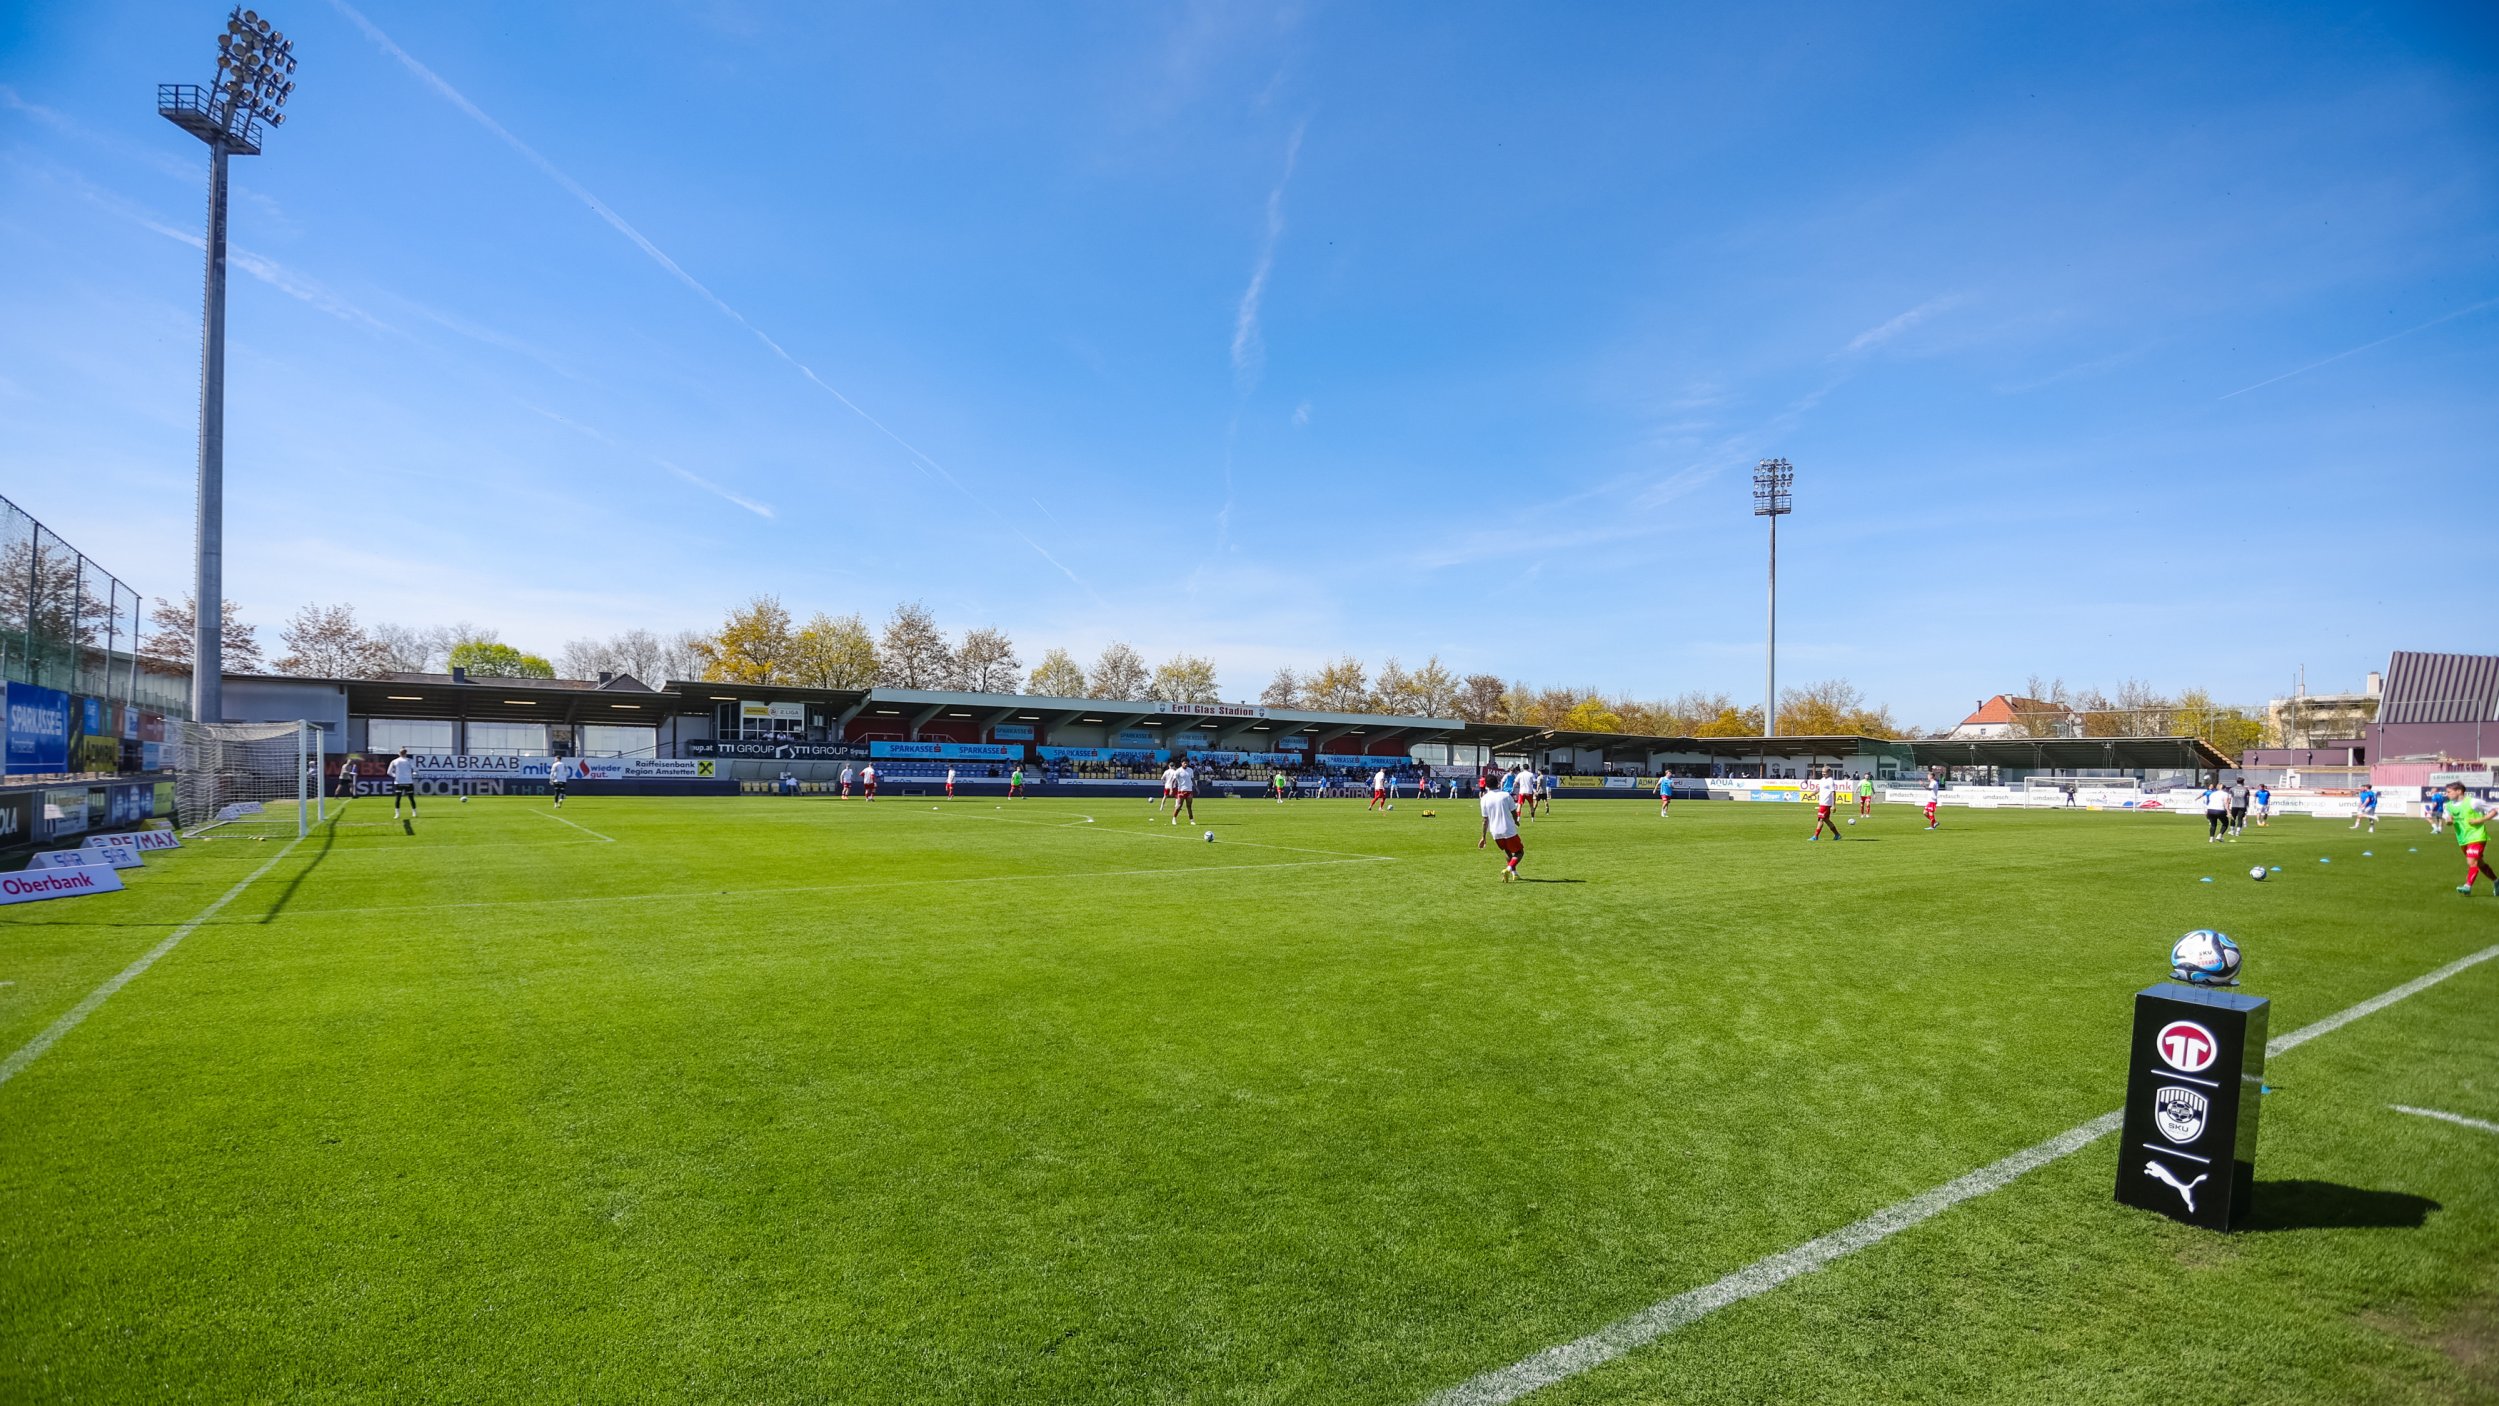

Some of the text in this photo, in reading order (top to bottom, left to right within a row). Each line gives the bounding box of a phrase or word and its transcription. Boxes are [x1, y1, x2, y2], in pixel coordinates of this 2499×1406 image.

[1172, 704, 1254, 716] Ertl Glas Stadion
[718, 744, 735, 753] TTI
[736, 745, 775, 753] GROUP
[794, 746, 810, 754] TTI
[812, 746, 848, 755] GROUP
[889, 744, 1000, 754] SPARKASSE SPARKASSE
[1053, 749, 1091, 757] SPARKASSE
[591, 764, 622, 772] wieder
[635, 760, 695, 768] Raiffeisenbank
[625, 767, 654, 776] Region
[356, 781, 393, 795] SIE
[3, 871, 95, 895] Oberbank
[2168, 1122, 2189, 1132] SKU
